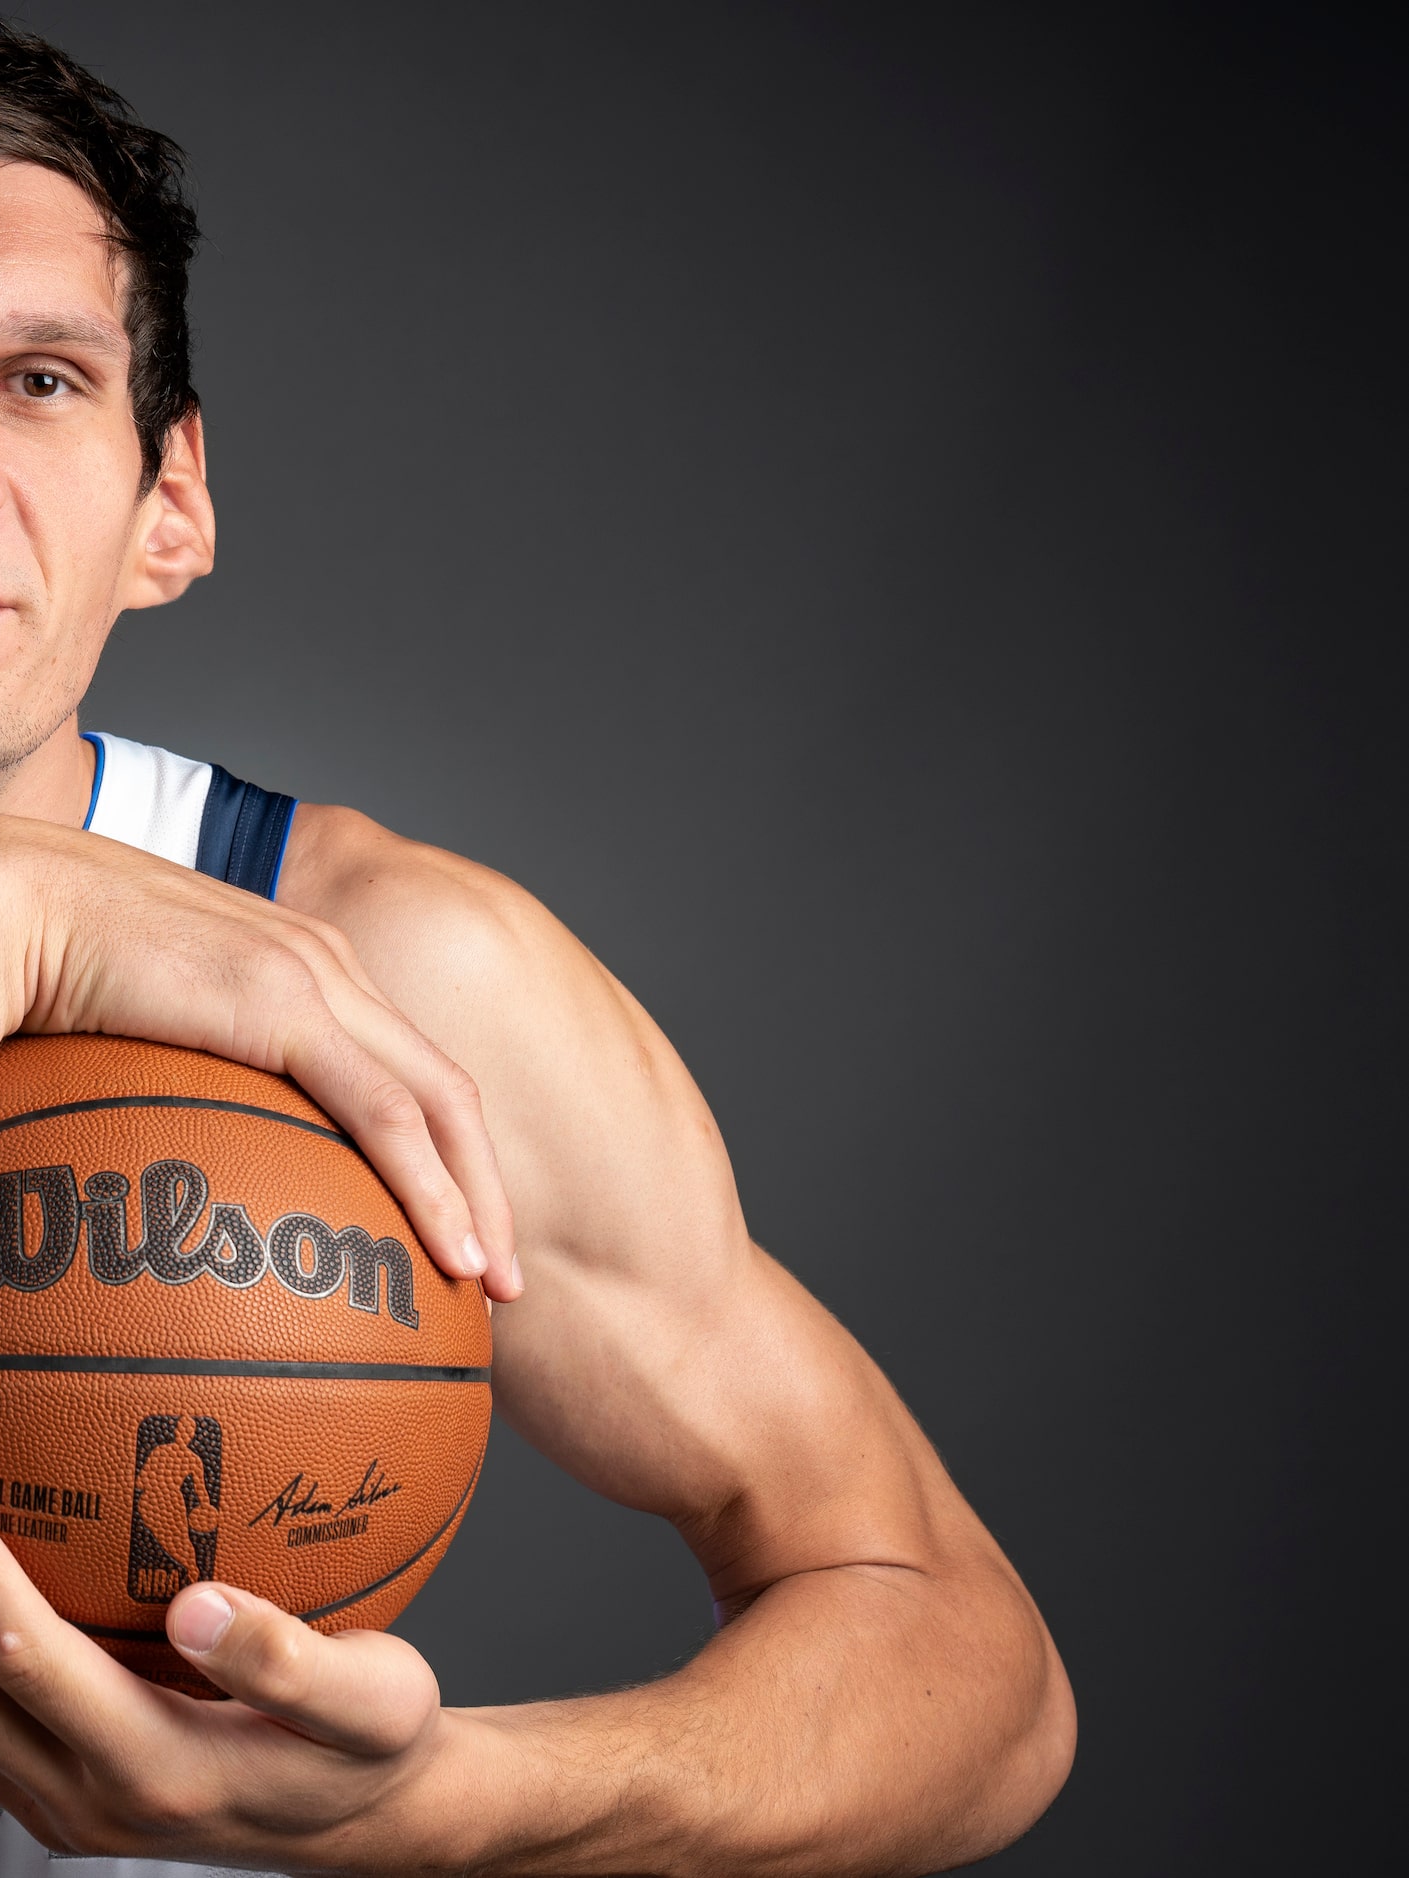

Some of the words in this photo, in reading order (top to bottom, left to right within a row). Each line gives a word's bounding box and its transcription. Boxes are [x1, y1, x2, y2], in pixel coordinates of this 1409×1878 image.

[9, 1480, 58, 1516] GAME
[60, 1489, 103, 1521] BALL
[16, 1514, 68, 1544] LEATHER
[287, 1514, 369, 1548] COMMISSIONER
[136, 1567, 180, 1597] NBA
